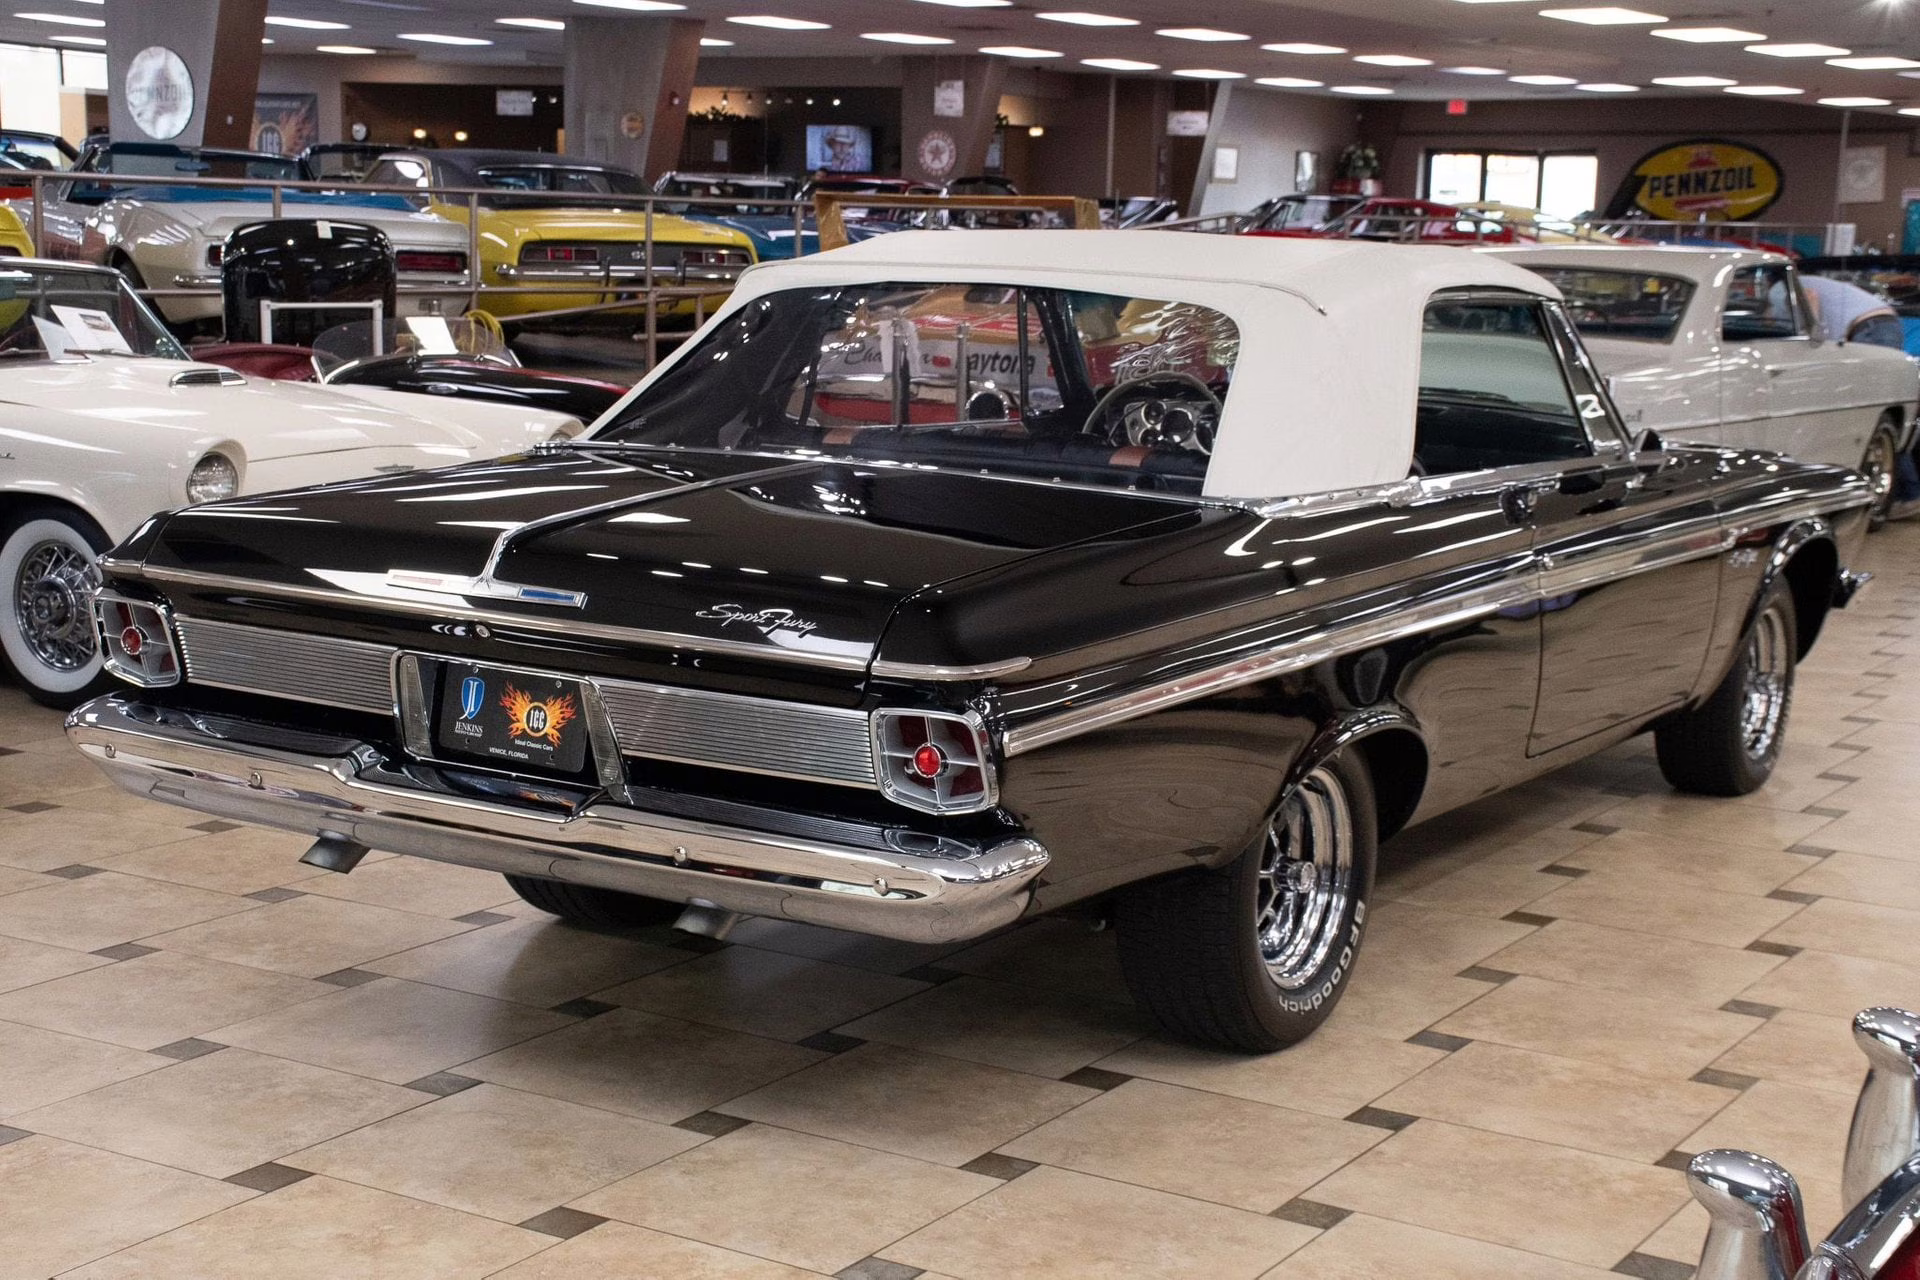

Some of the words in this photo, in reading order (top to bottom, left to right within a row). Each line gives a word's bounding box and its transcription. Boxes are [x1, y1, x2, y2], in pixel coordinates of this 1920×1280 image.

[1648, 165, 1756, 199] PENNZOIL
[696, 603, 774, 627] Sport
[758, 608, 817, 638] Fury
[455, 721, 484, 734] JENKINS
[529, 708, 546, 730] ICC
[489, 746, 508, 756] VENICE,
[508, 750, 529, 760] FLORIDA
[1279, 899, 1365, 1016] BFGoodrich
